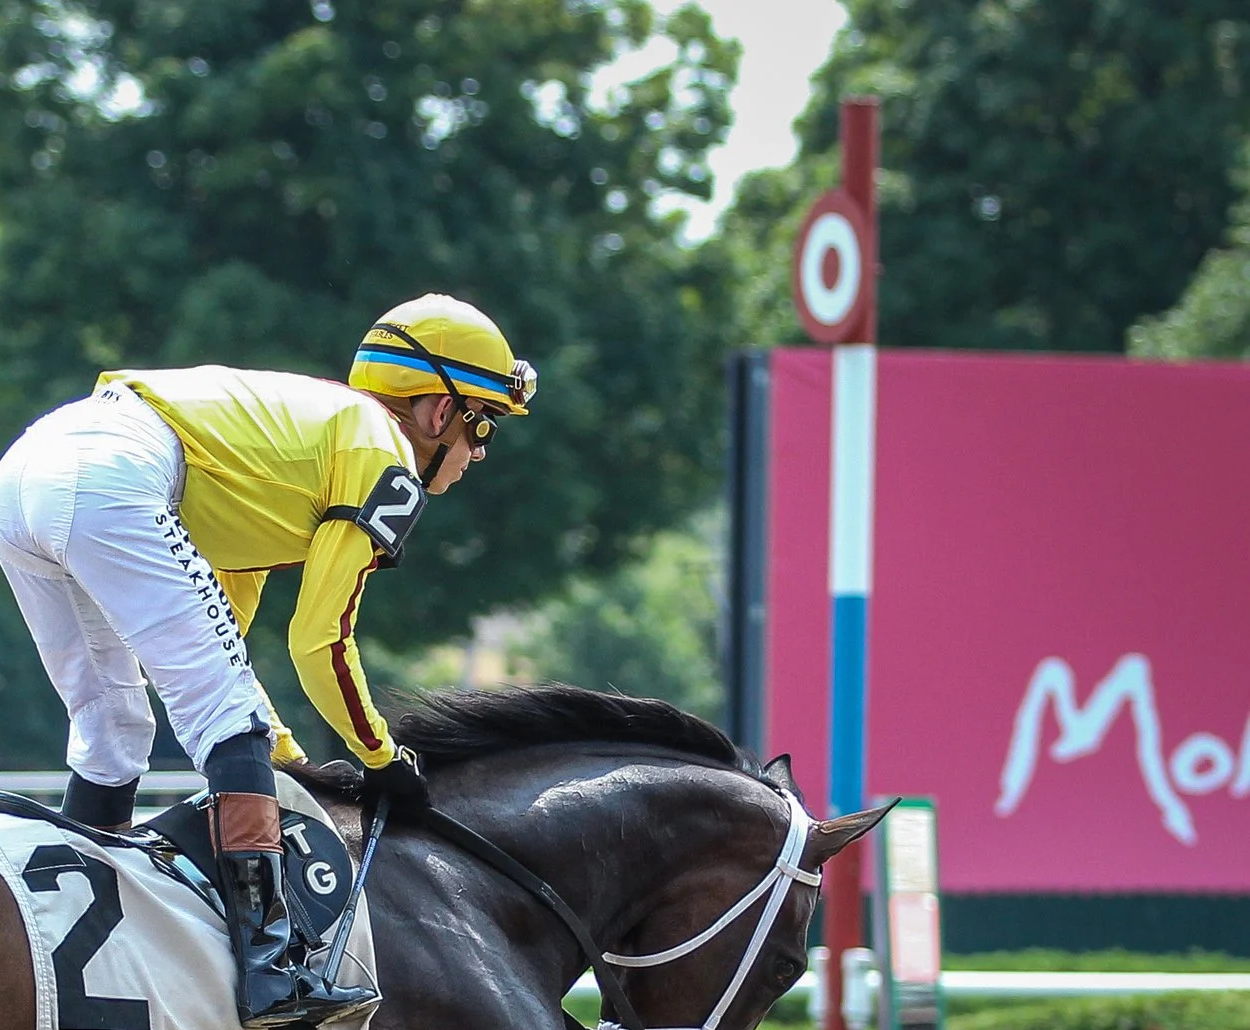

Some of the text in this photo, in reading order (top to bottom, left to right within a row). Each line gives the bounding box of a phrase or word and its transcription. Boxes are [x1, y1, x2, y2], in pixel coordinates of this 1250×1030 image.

[368, 475, 420, 544] 2
[155, 513, 241, 667] STEAKHOUSE
[995, 652, 1250, 848] Mo
